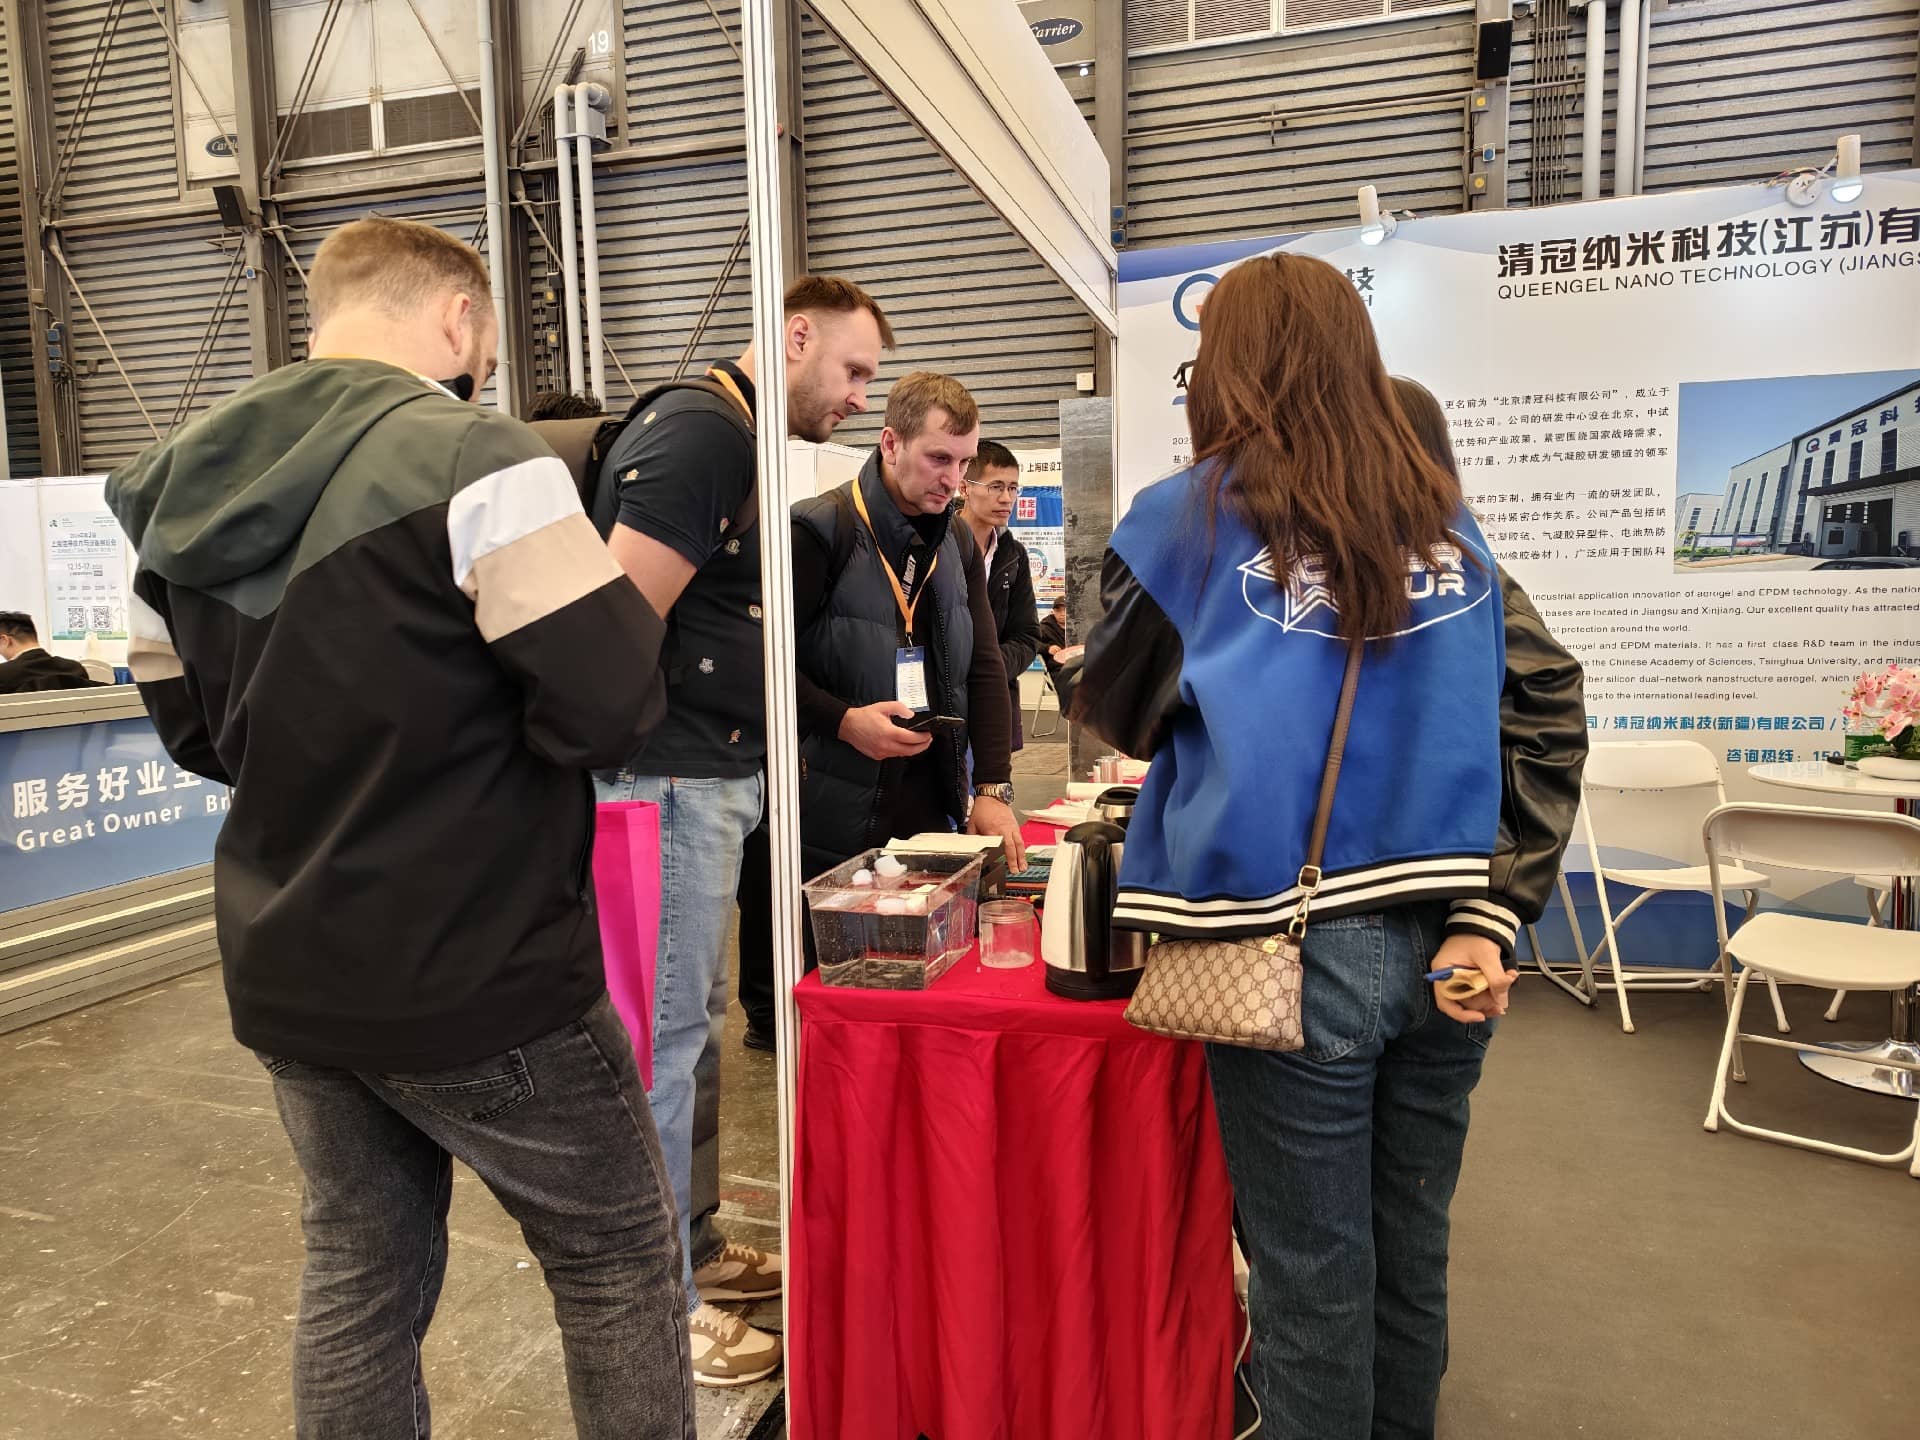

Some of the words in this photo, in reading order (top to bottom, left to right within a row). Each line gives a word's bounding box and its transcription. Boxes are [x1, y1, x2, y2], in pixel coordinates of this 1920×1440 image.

[588, 30, 608, 54] 19
[1498, 277, 1610, 300] QUEENGEL
[1615, 270, 1675, 290] NANO
[1680, 258, 1834, 285] TECHNOLOGY
[1839, 251, 1920, 275] (JIANG
[1578, 591, 1629, 601] application
[1632, 590, 1681, 599] innovation
[1684, 589, 1694, 598] of
[1737, 588, 1756, 597] and
[1758, 588, 1790, 596] EPDM
[1792, 587, 1851, 597] technology.
[1854, 586, 1868, 595] As
[1872, 586, 1888, 594] the
[1545, 609, 1574, 617] bases
[1593, 608, 1628, 616] located
[1630, 608, 1639, 616] in
[1641, 607, 1678, 617] Jiangsu
[1680, 606, 1699, 615] and
[1746, 606, 1765, 614] Our
[1767, 605, 1813, 614] excellent
[1815, 605, 1848, 614] quality
[1851, 604, 1870, 612] has
[1873, 603, 1920, 612] attracted
[1561, 626, 1608, 634] protection
[1610, 625, 1643, 633] around
[1599, 641, 1617, 649] and
[1620, 641, 1651, 649] EPDM
[1654, 641, 1701, 649] materials.
[1802, 639, 1826, 647] R&D
[1829, 639, 1855, 647] team
[1859, 639, 1868, 647] in
[1873, 639, 1889, 647] the
[1609, 658, 1648, 666] Chinese
[1649, 658, 1694, 667] Academy
[1696, 658, 1706, 666] of
[1708, 657, 1756, 666] Sciences,
[1759, 657, 1804, 666] Tsinghua
[1863, 656, 1883, 665] and
[1606, 675, 1636, 683] silicon
[1706, 674, 1774, 683] nanostructure
[1776, 674, 1817, 684] aerogel,
[1821, 673, 1850, 682] which
[1633, 691, 1693, 699] international
[1694, 691, 1730, 701] leading
[16, 819, 96, 851] Great
[103, 804, 183, 833] Owner
